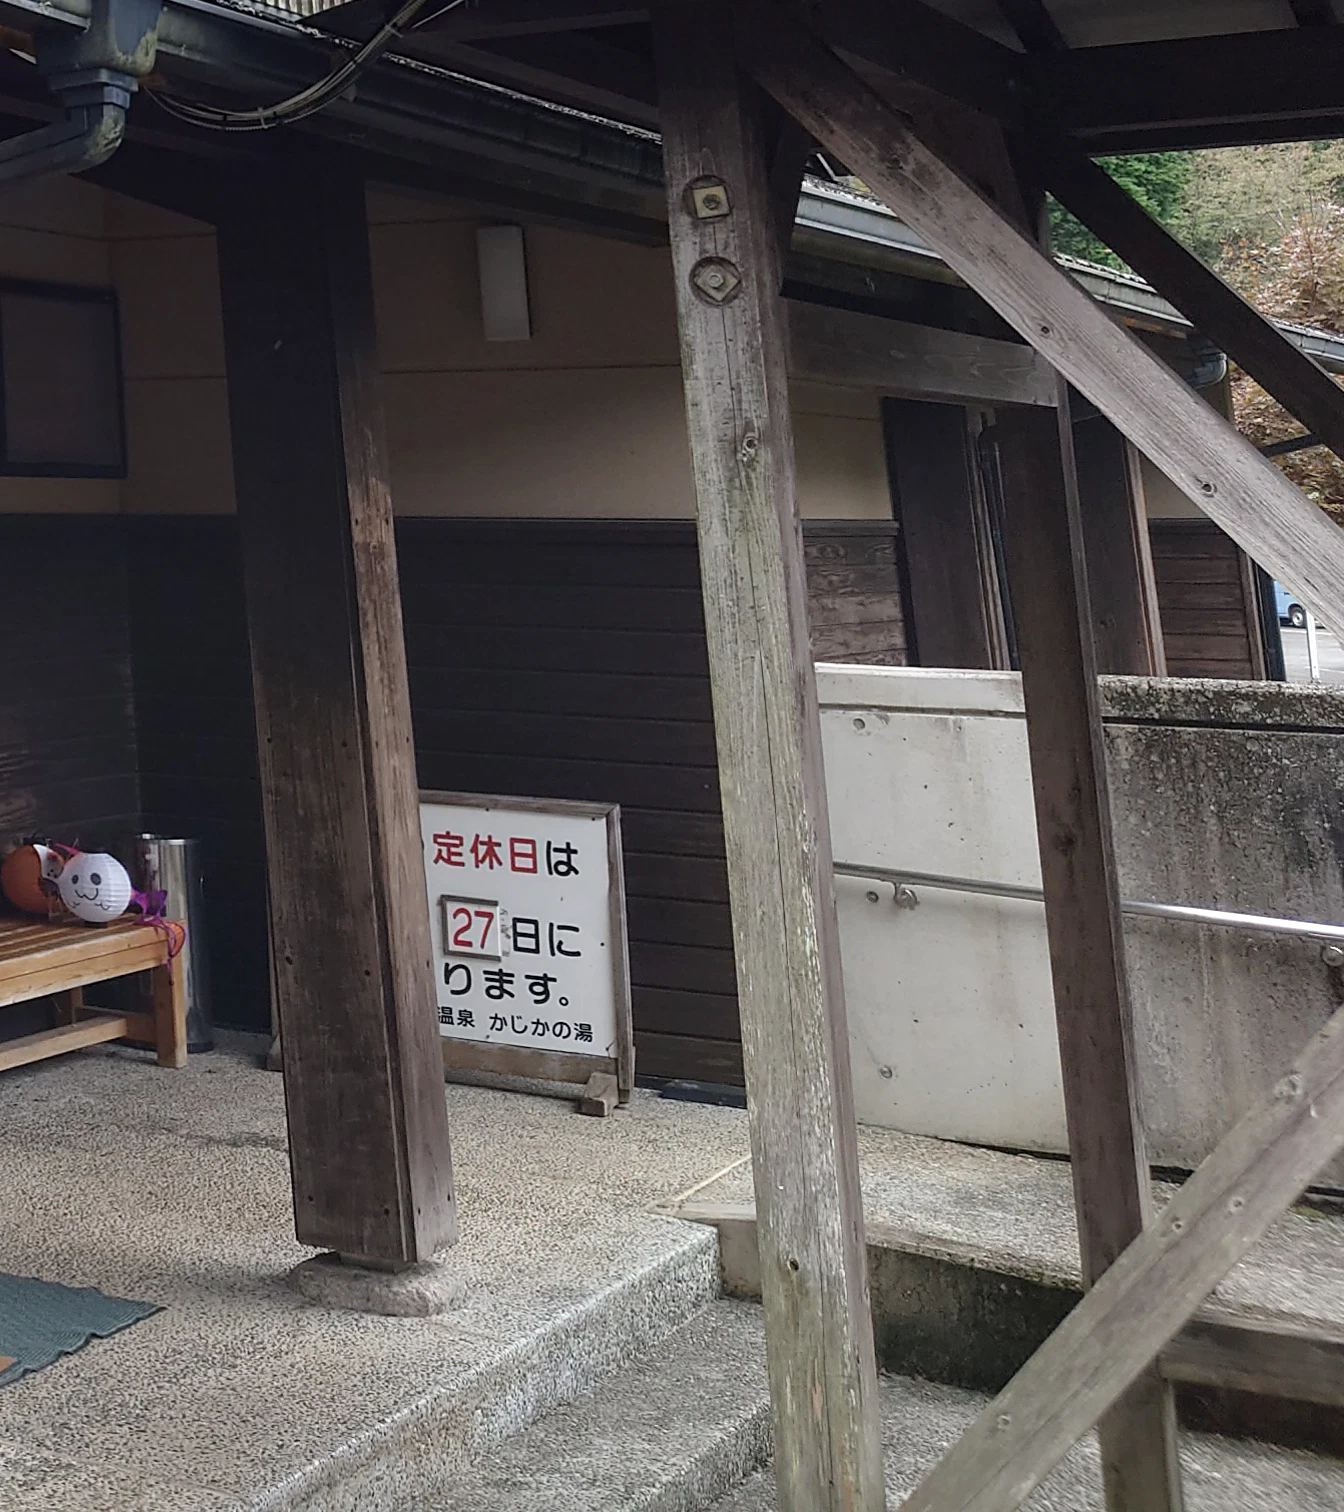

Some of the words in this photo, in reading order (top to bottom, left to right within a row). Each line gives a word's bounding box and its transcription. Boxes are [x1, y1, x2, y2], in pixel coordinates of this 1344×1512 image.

[432, 830, 580, 877] 定休日は
[443, 961, 570, 1007] ります。
[437, 1006, 475, 1028] 温泉
[489, 1013, 593, 1043] かじかの湯
